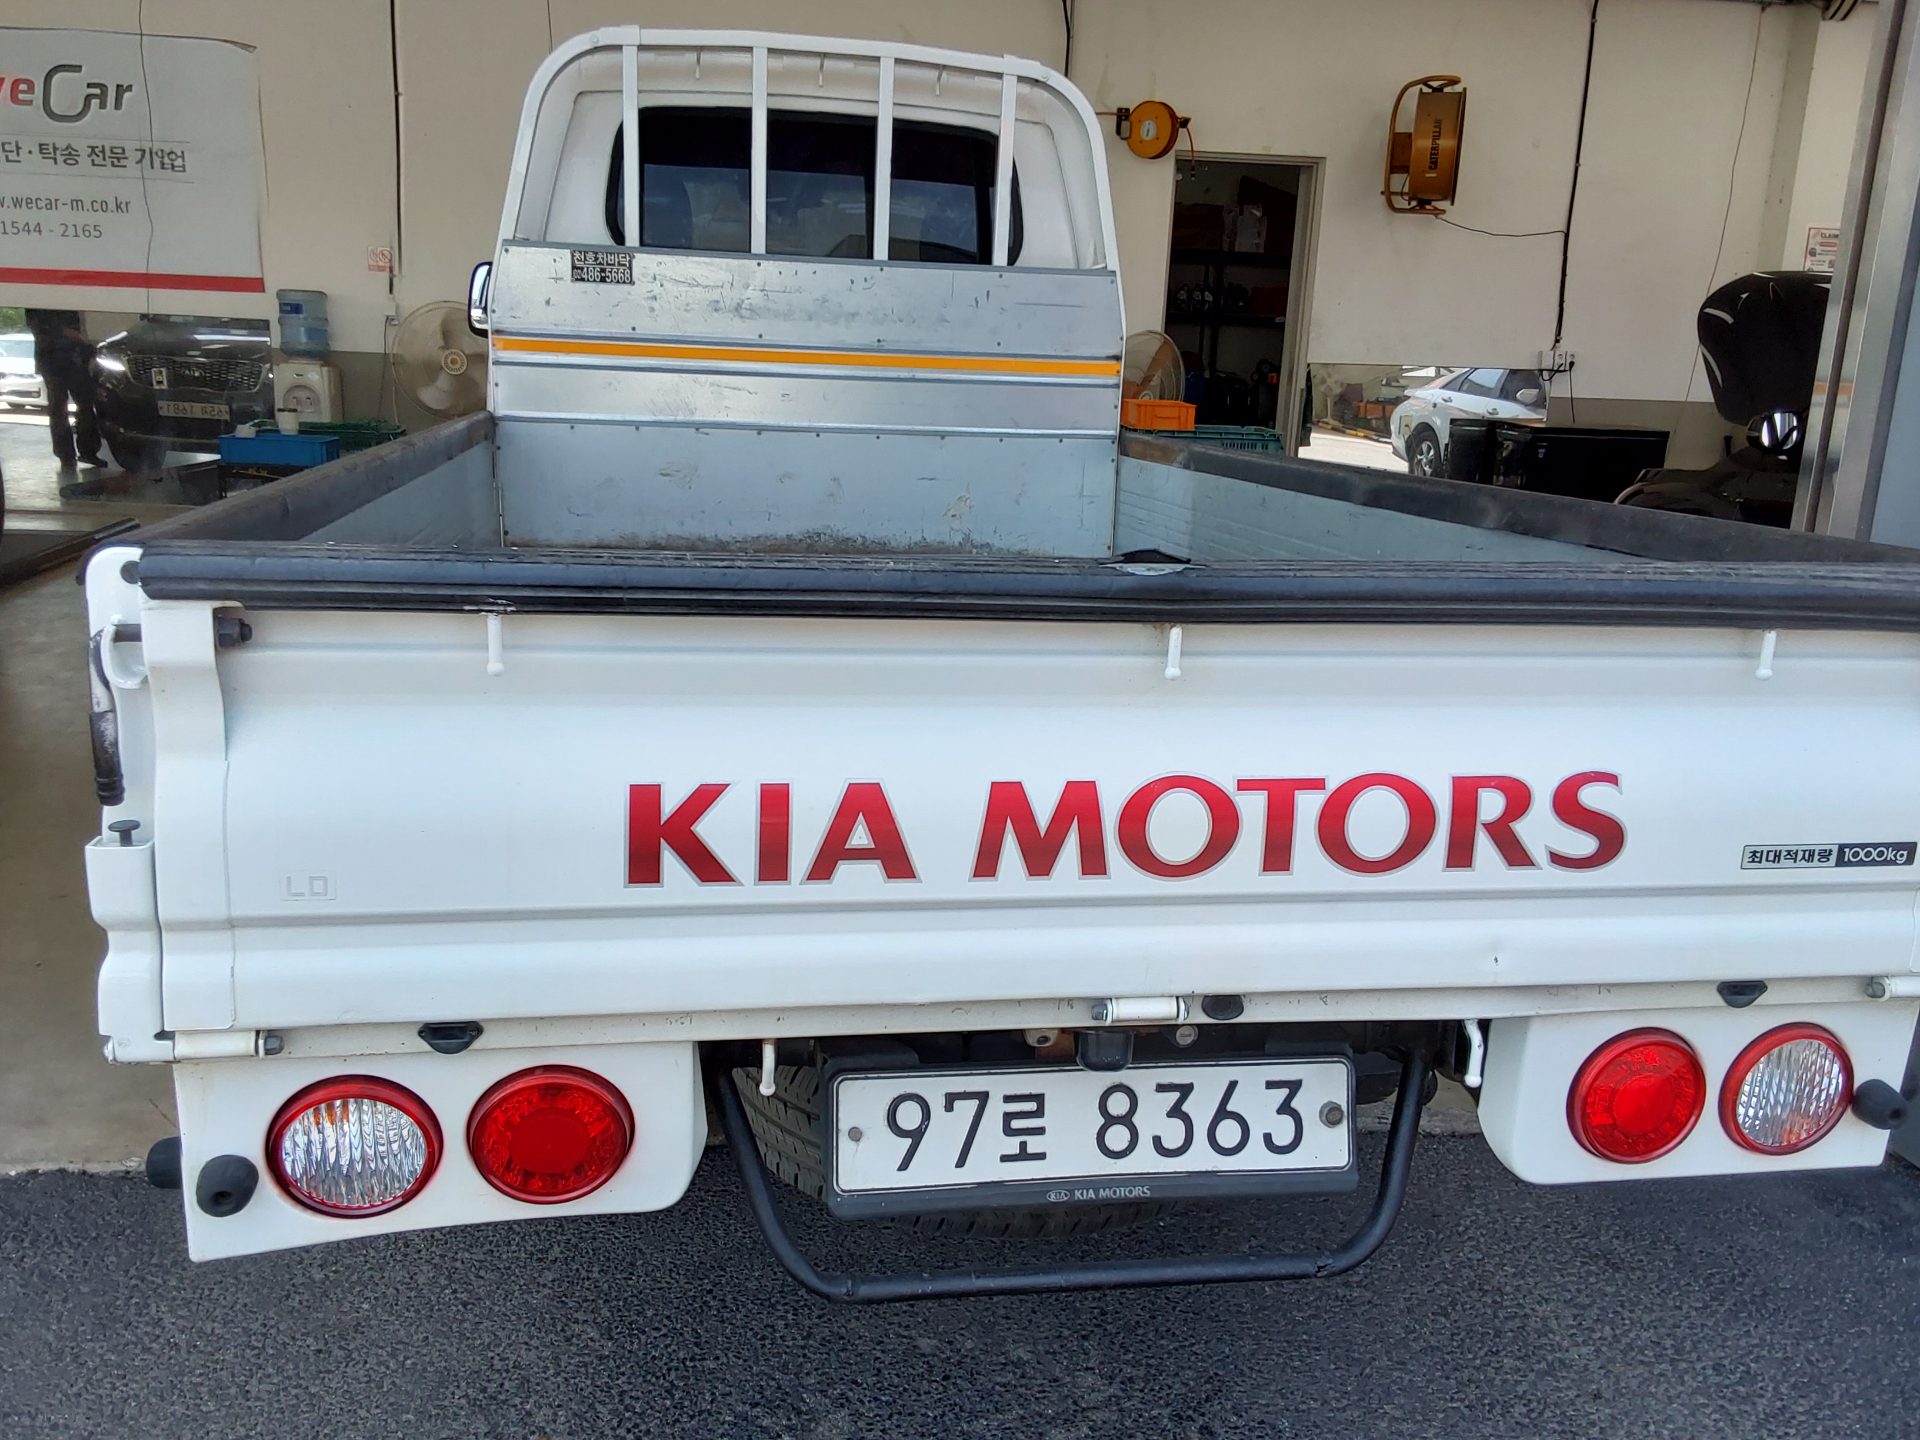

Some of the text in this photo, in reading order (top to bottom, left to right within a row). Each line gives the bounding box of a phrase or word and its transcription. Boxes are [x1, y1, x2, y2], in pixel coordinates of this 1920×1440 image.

[0, 64, 133, 123] eCar
[86, 144, 128, 169] 전문
[1428, 118, 1442, 171] CATERPILLAR
[1, 220, 43, 237] 1544
[59, 222, 103, 239] 2165
[573, 251, 631, 267] 천호차바닥
[624, 770, 1629, 888] KIA MOTORS
[1746, 847, 1908, 865] 최대적재량 1000kg
[887, 1078, 1304, 1172] 97로 8363
[1046, 1185, 1151, 1202] KIA KIA MOTORS
